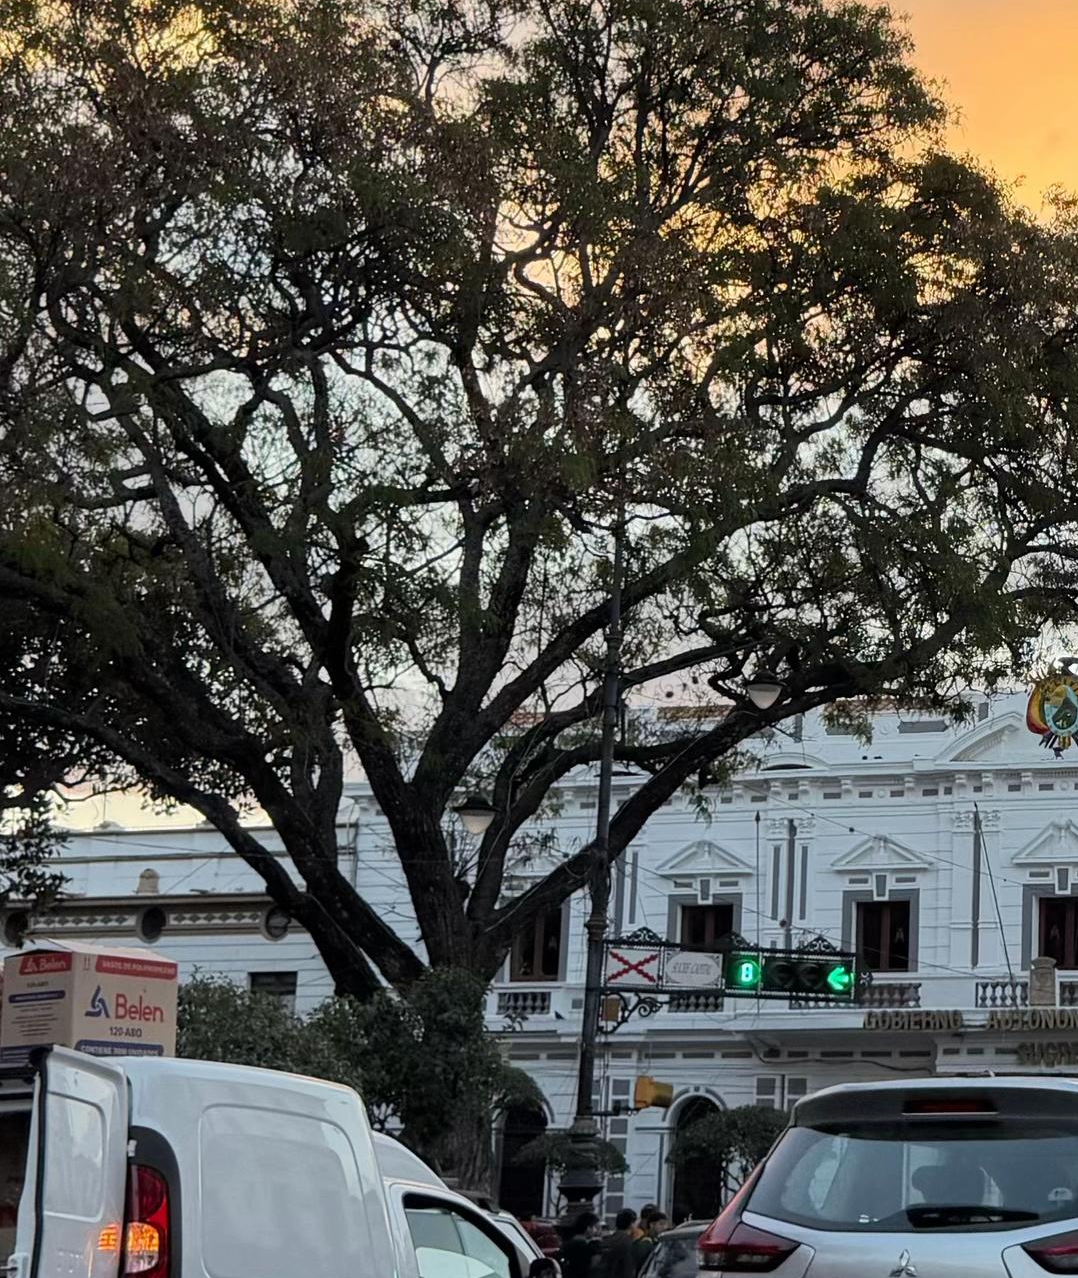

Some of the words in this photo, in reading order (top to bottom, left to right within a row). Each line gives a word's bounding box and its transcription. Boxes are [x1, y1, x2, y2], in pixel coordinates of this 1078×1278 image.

[39, 957, 66, 970] Belen
[115, 994, 164, 1021] Belen
[864, 1009, 963, 1030] GOBIERNO
